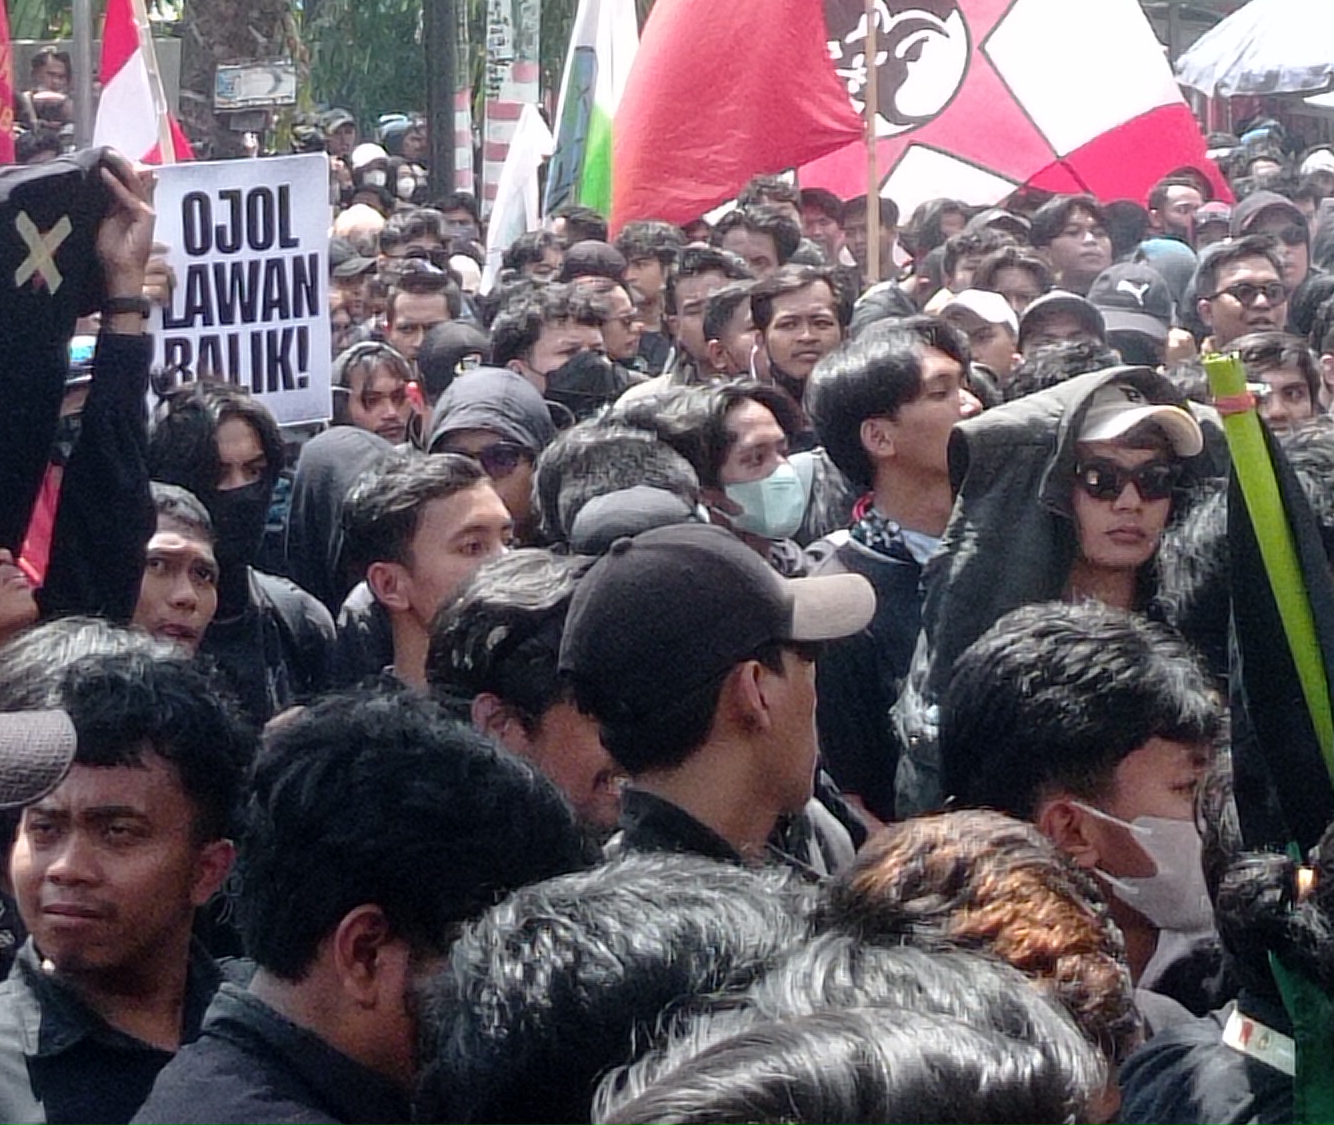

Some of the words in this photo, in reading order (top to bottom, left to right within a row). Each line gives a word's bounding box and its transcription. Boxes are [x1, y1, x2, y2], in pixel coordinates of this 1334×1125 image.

[181, 183, 299, 256] OJOL
[162, 252, 319, 330] LAWAN
[163, 325, 310, 395] BALIK!
